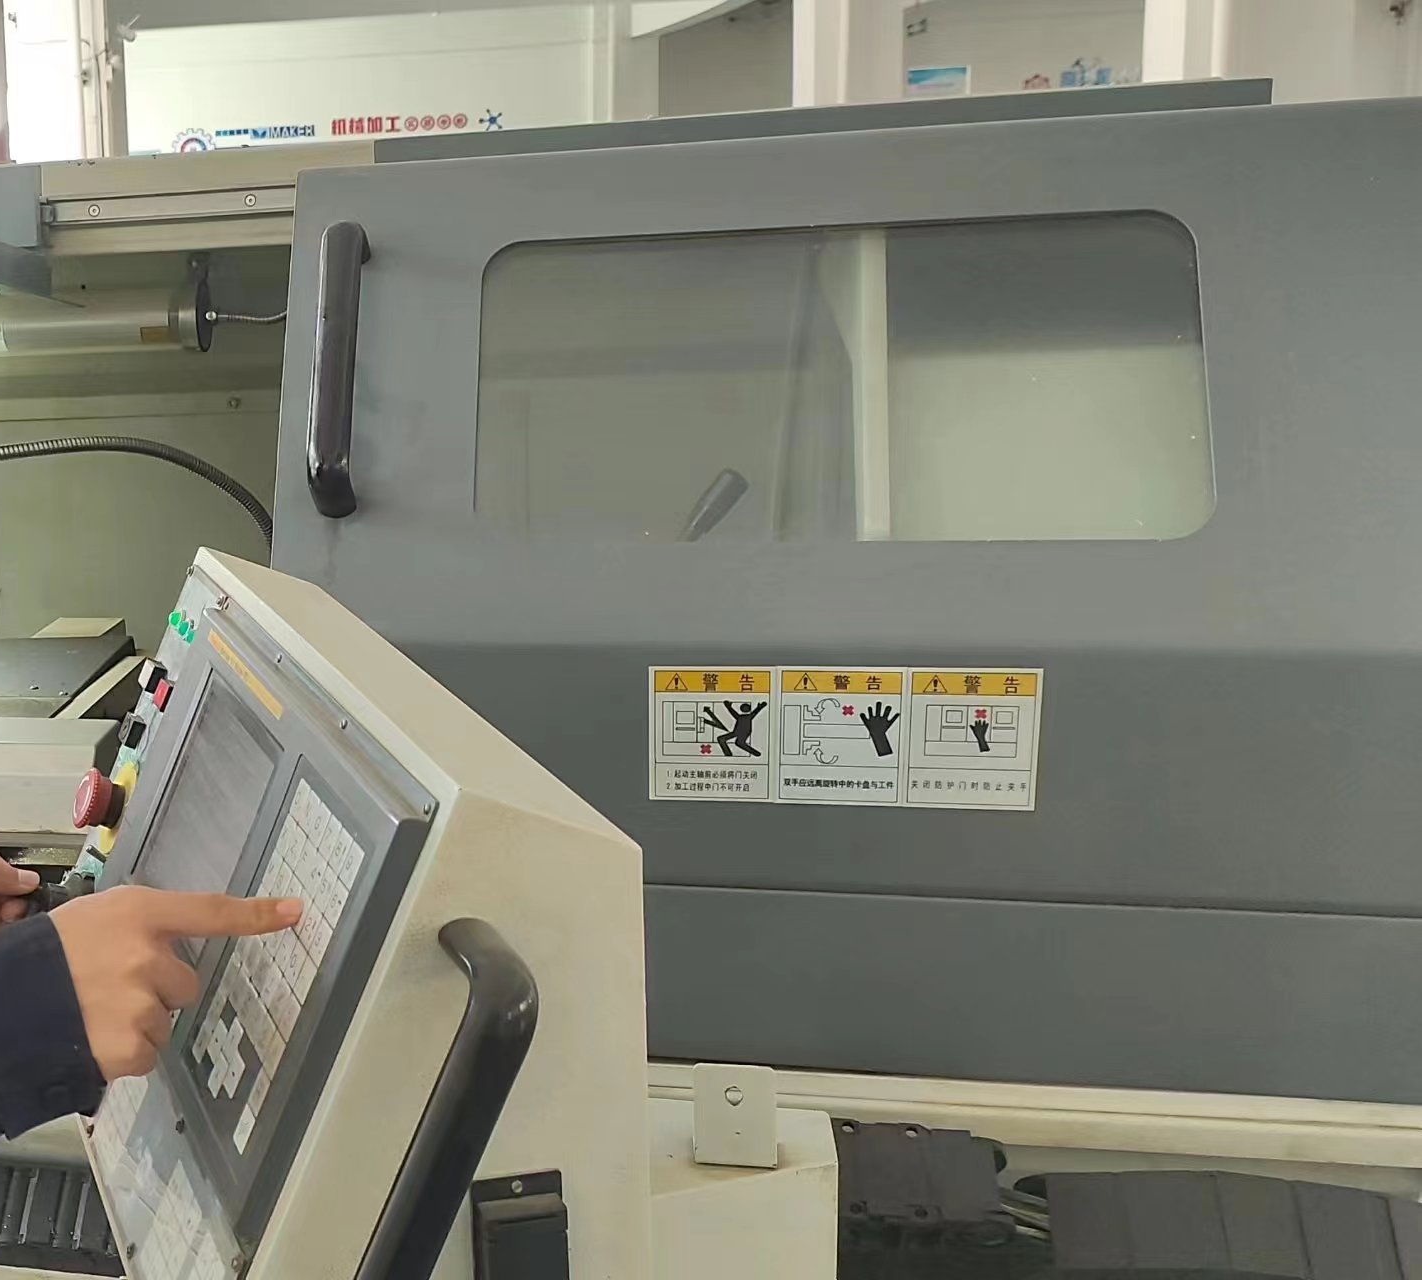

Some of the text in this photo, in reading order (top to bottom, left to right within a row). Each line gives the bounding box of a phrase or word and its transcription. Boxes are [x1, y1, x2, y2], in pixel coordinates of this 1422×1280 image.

[269, 125, 315, 138] MAKER
[702, 673, 755, 692] 警告
[834, 674, 883, 692] 警告
[963, 675, 1021, 694] 警告
